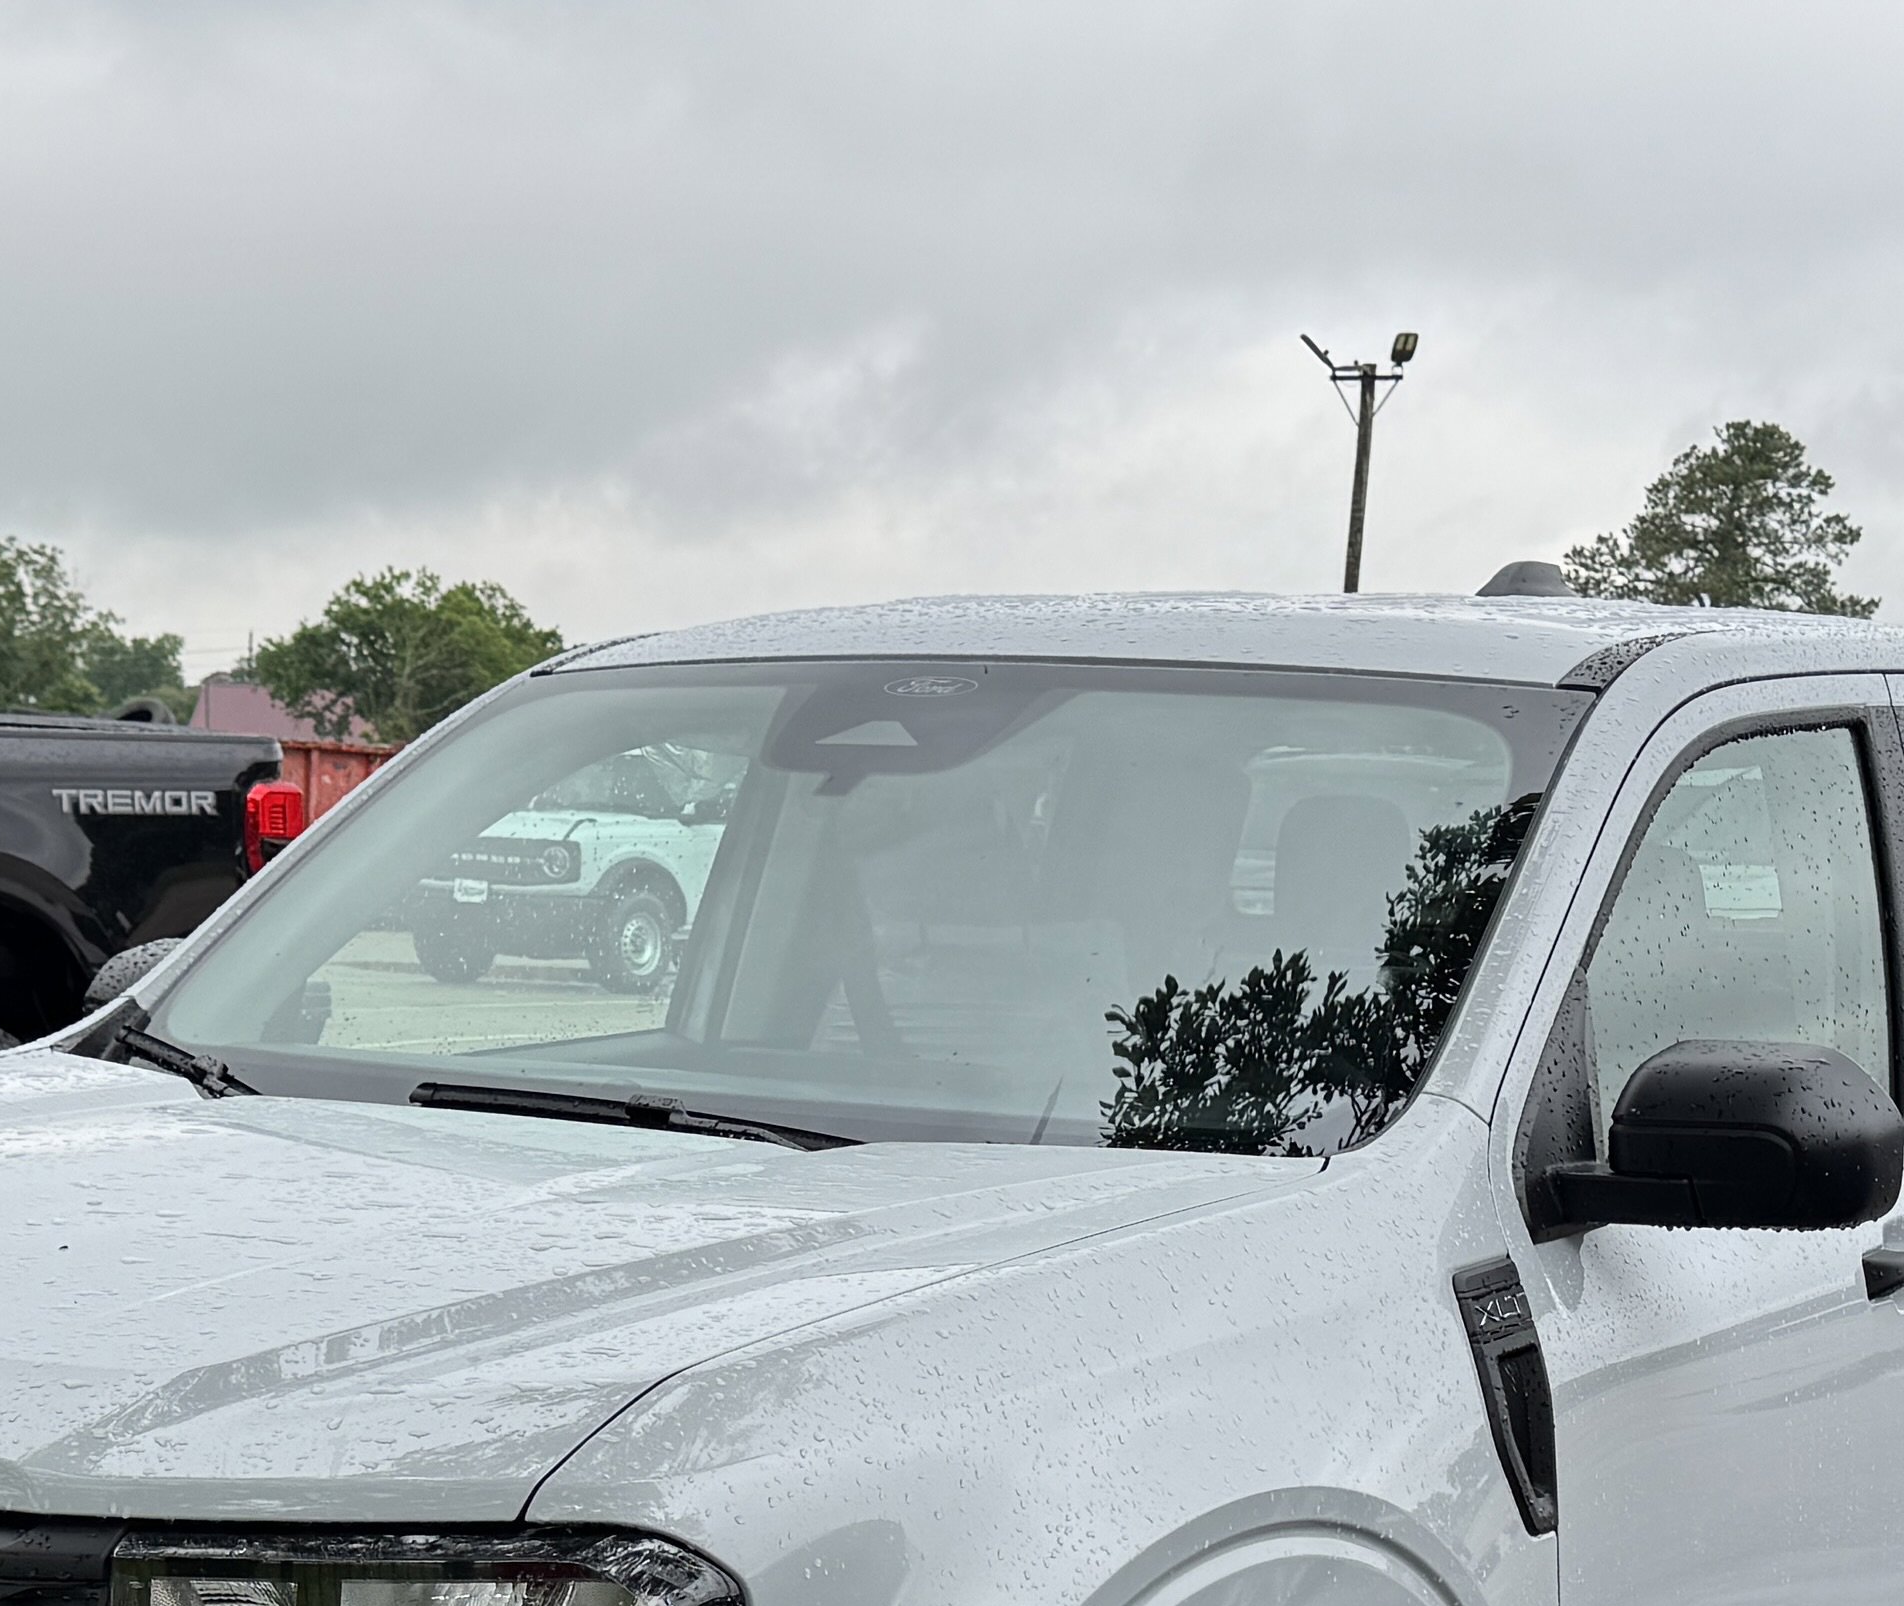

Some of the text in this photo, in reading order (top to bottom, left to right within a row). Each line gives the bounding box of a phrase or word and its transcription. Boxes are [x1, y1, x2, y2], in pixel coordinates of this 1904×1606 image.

[896, 678, 963, 694] Ford
[51, 788, 220, 816] TREMOR
[1474, 1292, 1525, 1326] XLT
